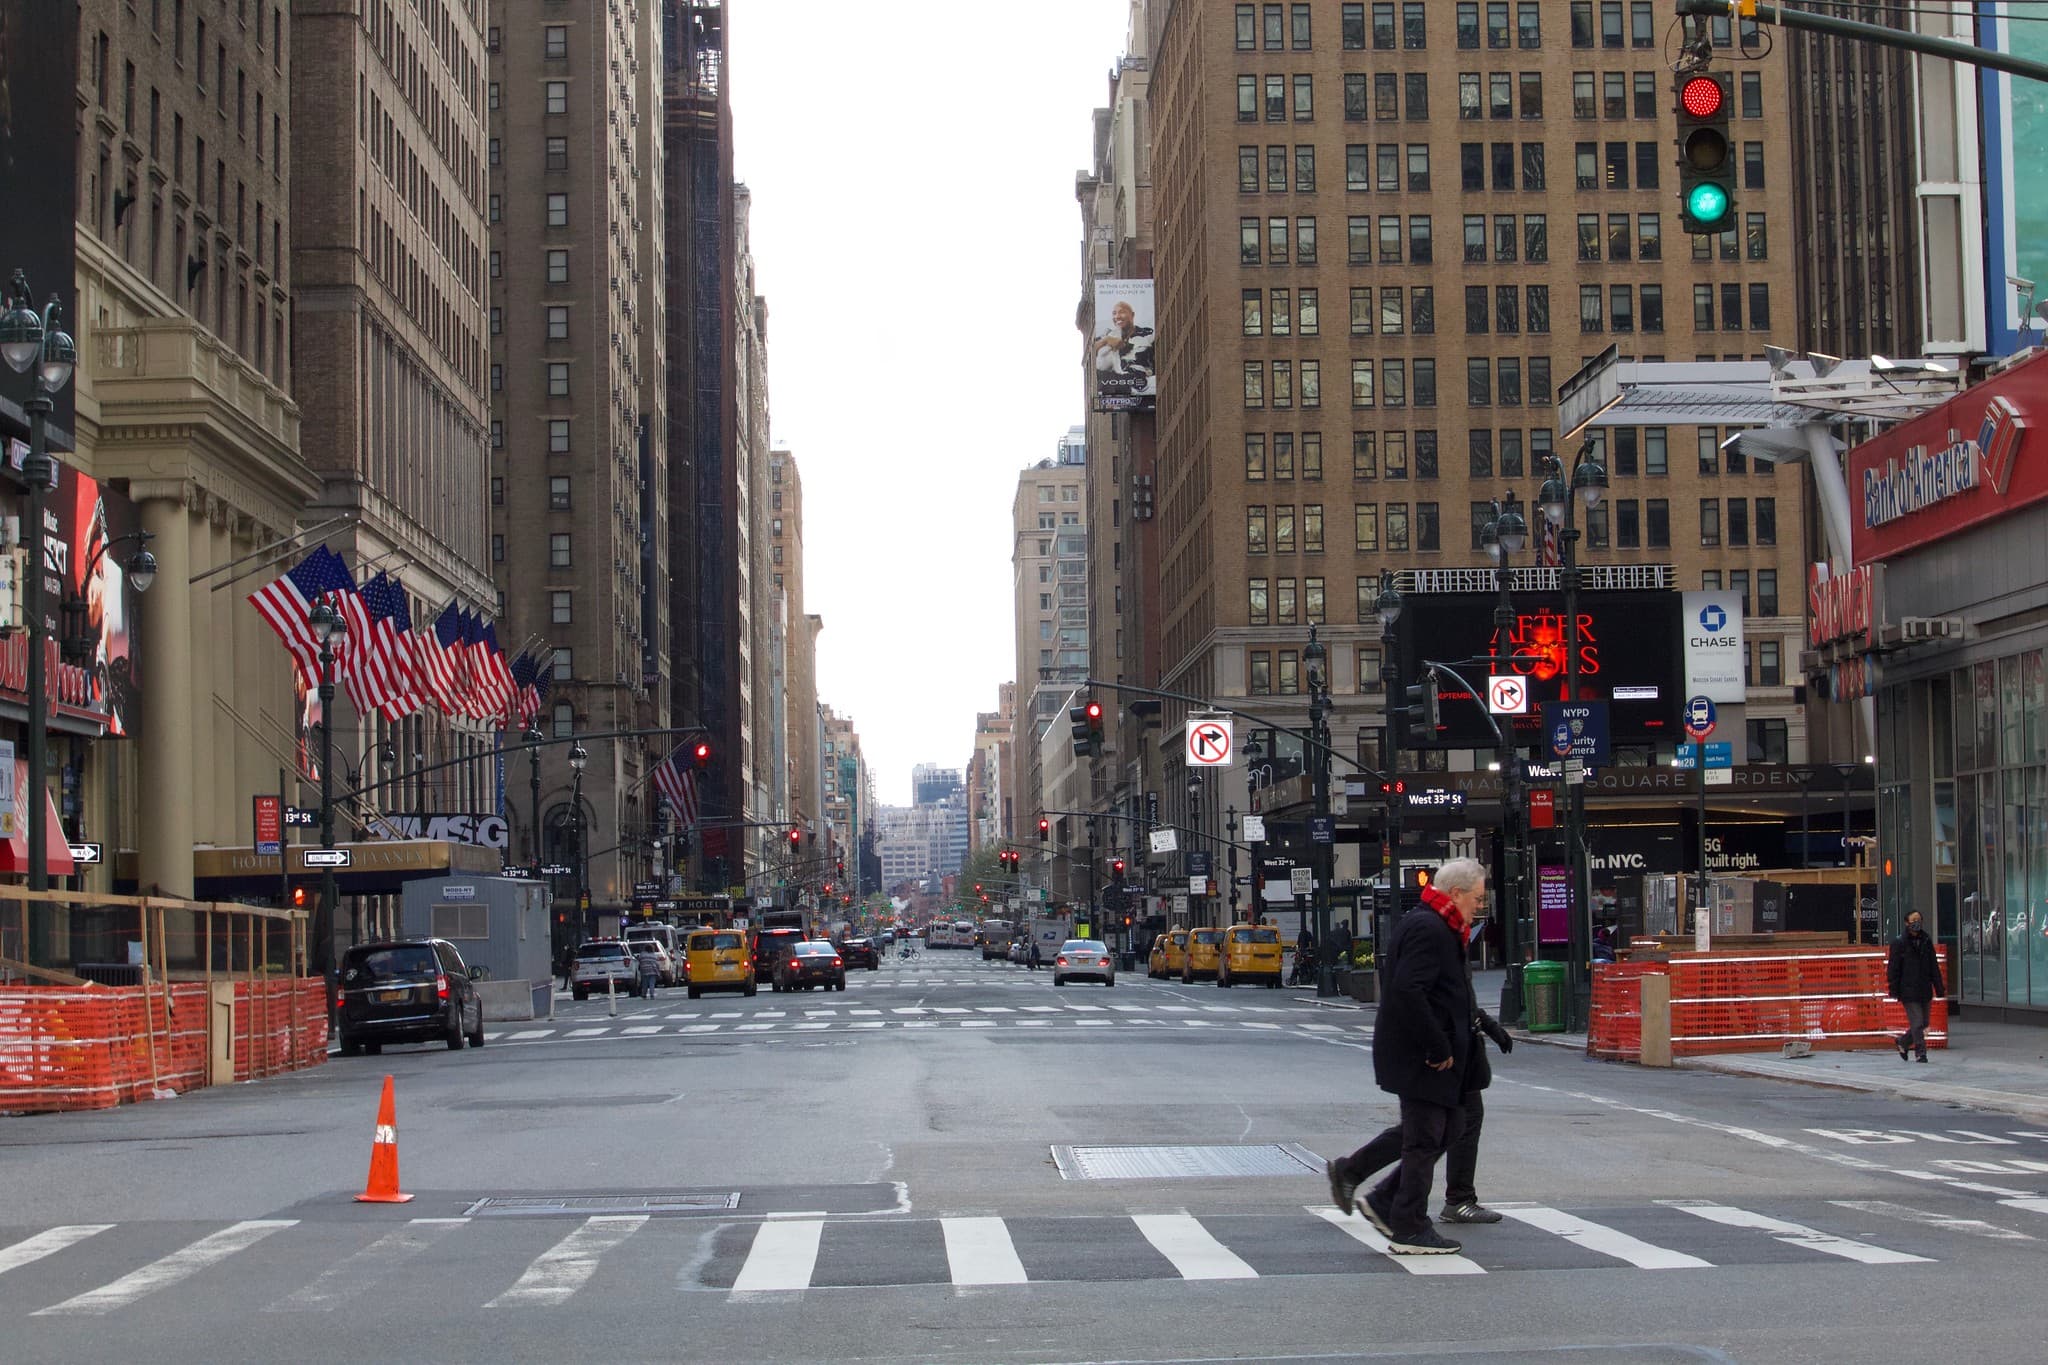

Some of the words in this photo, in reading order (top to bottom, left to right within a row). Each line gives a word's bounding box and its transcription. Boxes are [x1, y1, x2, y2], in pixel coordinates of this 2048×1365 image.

[1864, 457, 1900, 530] Bank
[1912, 428, 1977, 508] America
[1414, 568, 1500, 593] MADISON
[1592, 565, 1664, 590] GARDEN
[1809, 558, 1874, 649] Subway
[1690, 637, 1737, 648] CHASE
[1562, 708, 1590, 717] NYPD
[1409, 794, 1432, 805] West
[1434, 794, 1451, 804] 33rd
[1452, 793, 1462, 804] St
[302, 813, 312, 823] St
[1704, 838, 1721, 852] 5G
[1591, 856, 1605, 869] in
[1608, 854, 1647, 869] NYC.
[1704, 853, 1730, 867] built
[1731, 853, 1760, 869] right.
[1292, 869, 1310, 877] STOP
